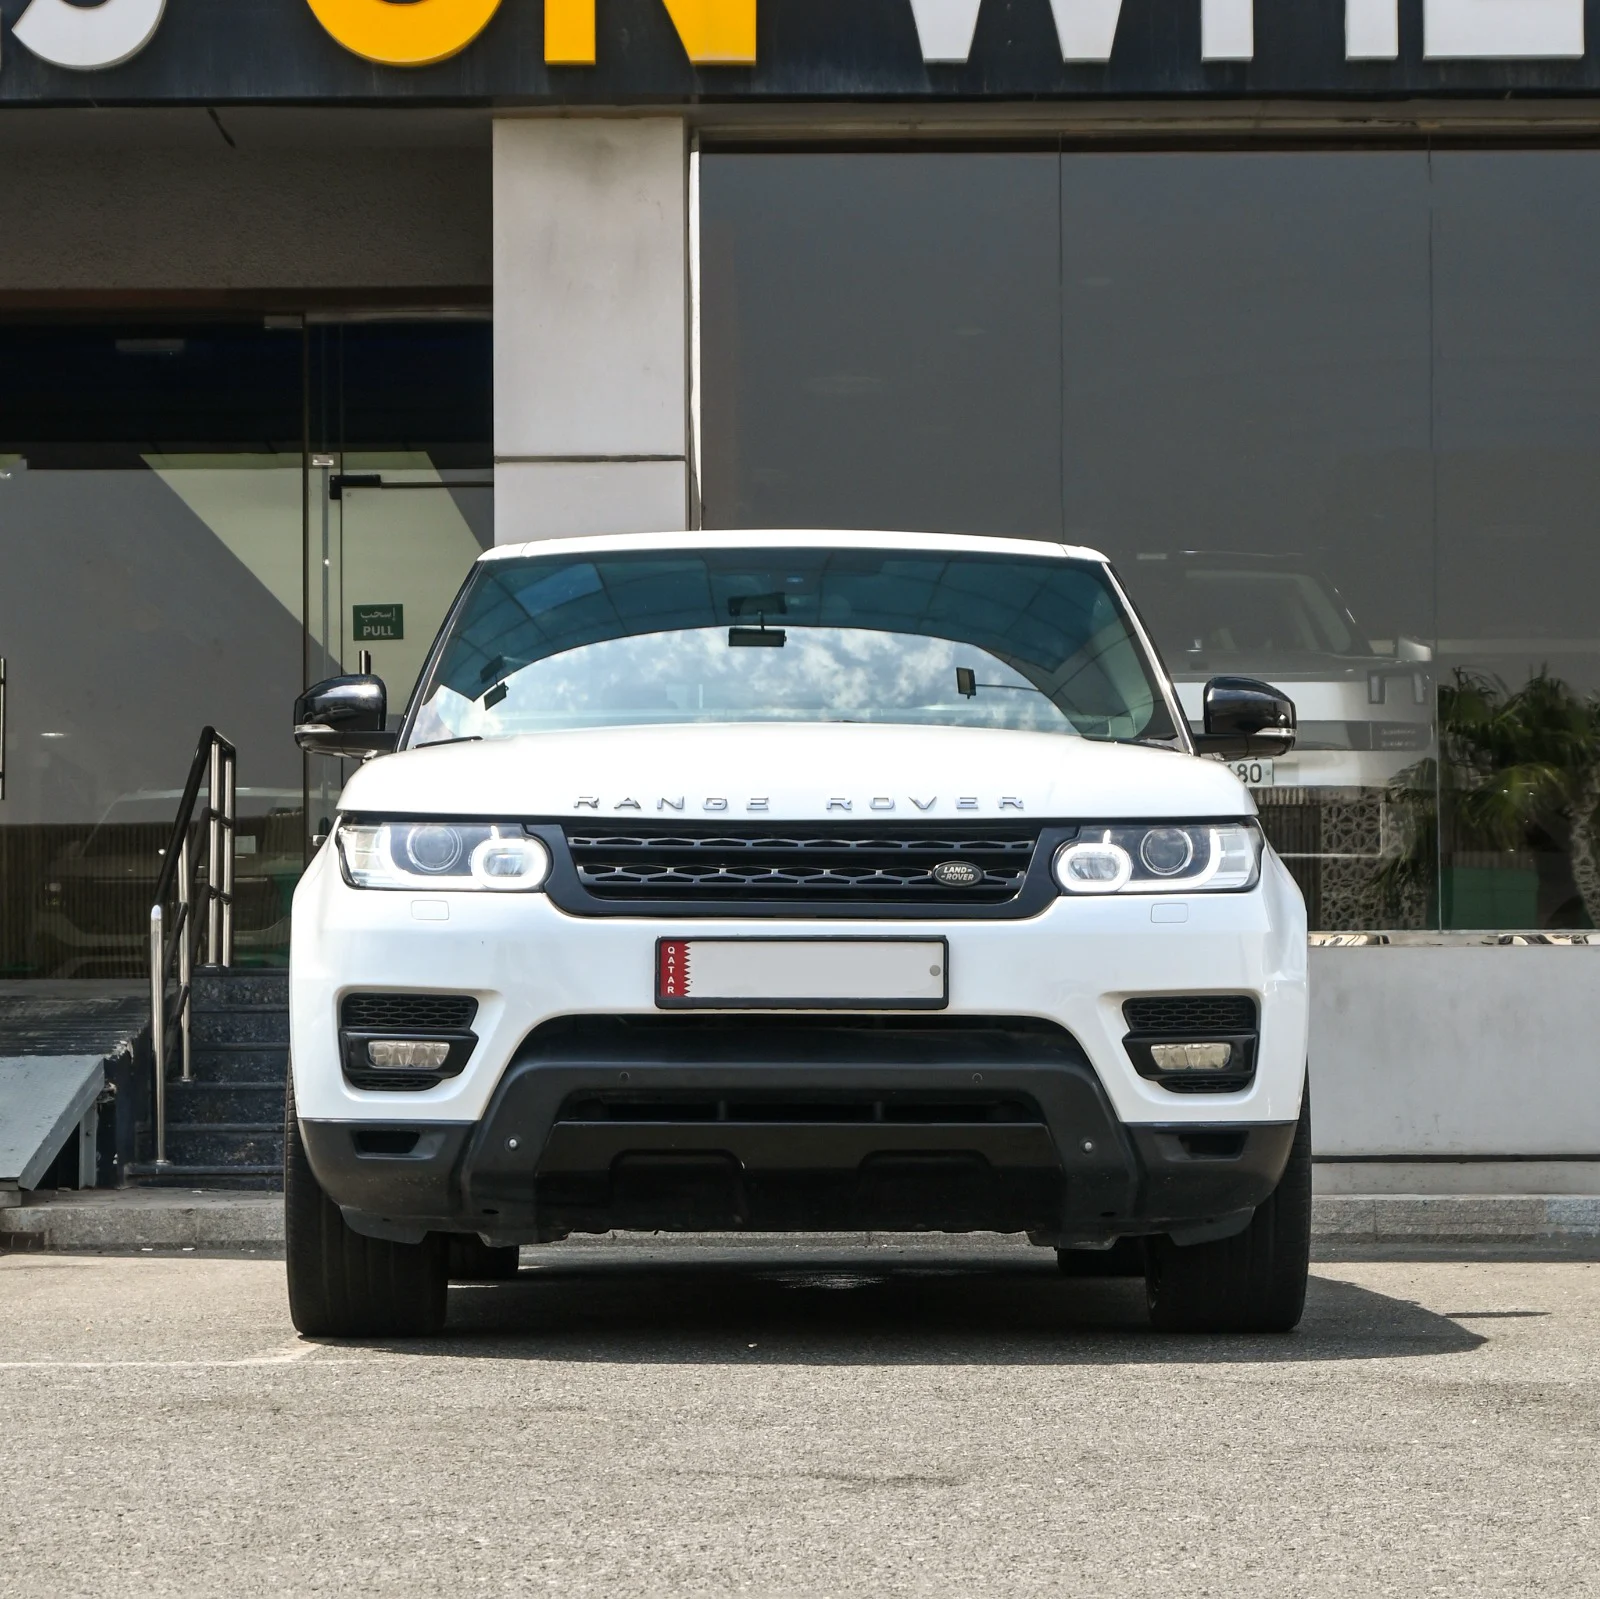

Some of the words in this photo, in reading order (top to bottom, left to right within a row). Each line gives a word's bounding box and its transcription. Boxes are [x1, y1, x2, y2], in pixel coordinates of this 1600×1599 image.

[363, 625, 394, 636] PULL
[573, 796, 769, 811] RANGE
[826, 796, 1024, 811] ROVER
[667, 946, 675, 994] QATAR
